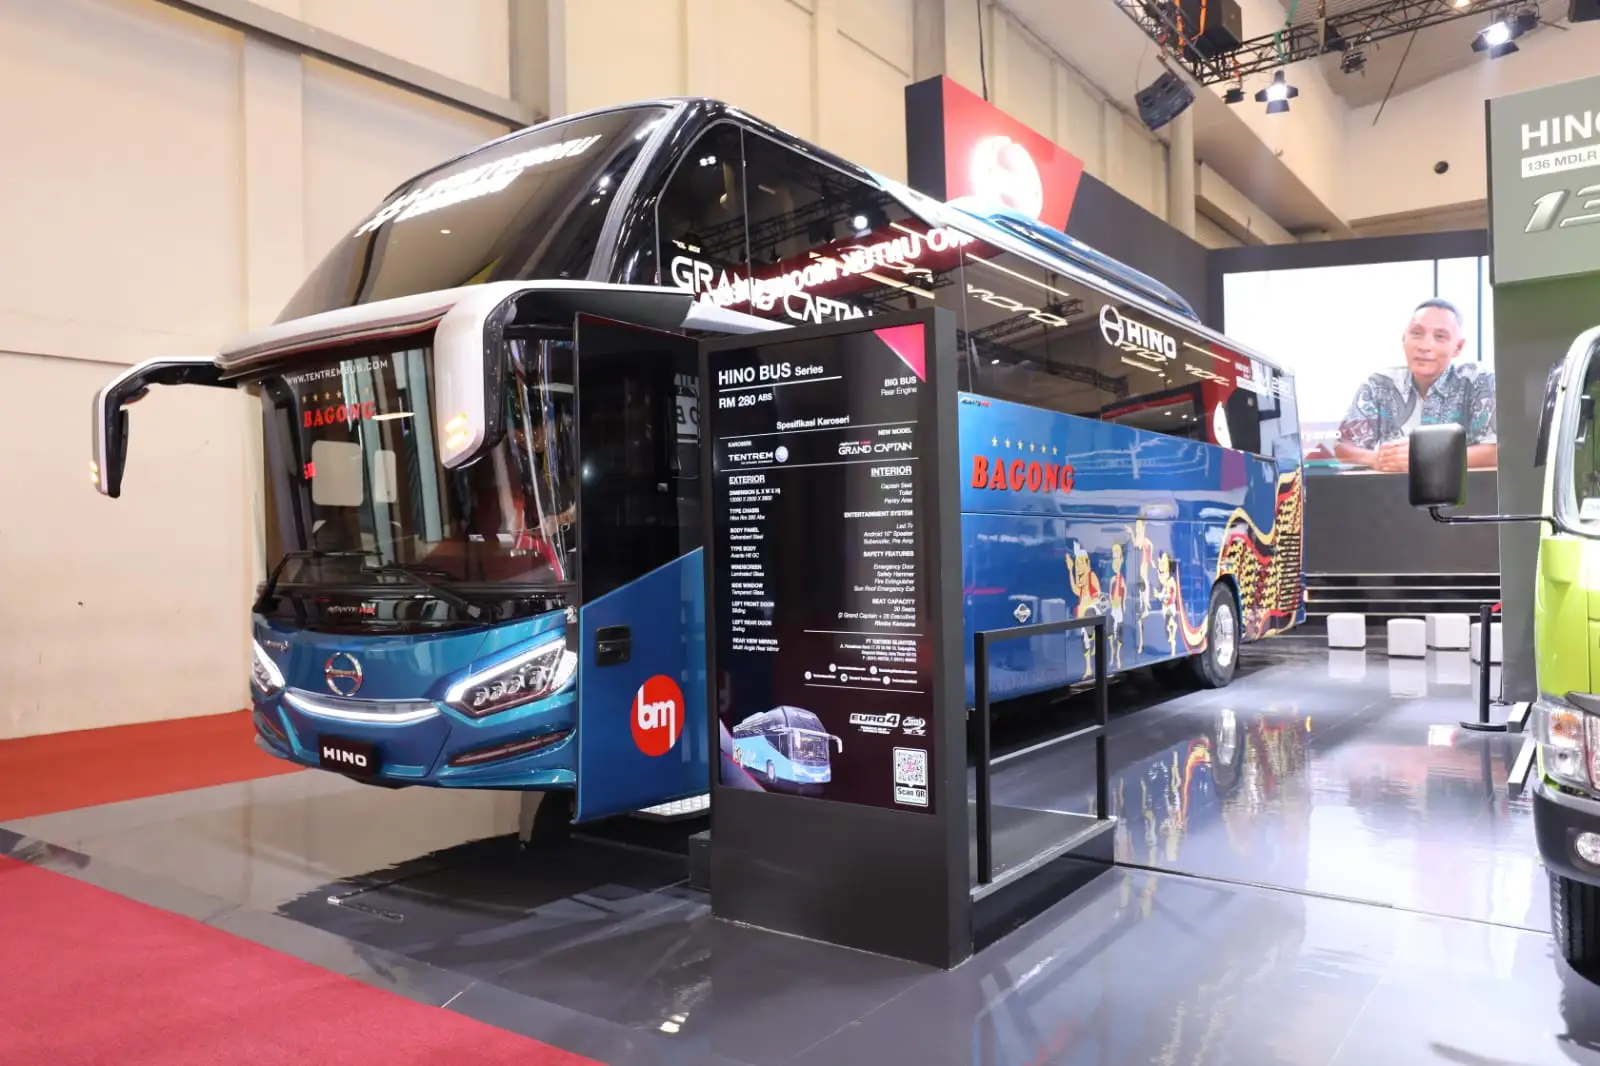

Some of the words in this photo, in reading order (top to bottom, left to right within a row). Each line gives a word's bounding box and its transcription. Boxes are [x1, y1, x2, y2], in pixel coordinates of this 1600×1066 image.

[1521, 110, 1600, 150] HIN
[1528, 159, 1550, 172] 136
[1554, 150, 1597, 169] MDLR
[1127, 320, 1177, 360] HINO
[719, 366, 755, 386] HINO
[759, 362, 791, 381] BUS
[794, 365, 824, 376] Series
[884, 378, 898, 387] BIG
[900, 376, 917, 385] BUS
[881, 388, 895, 396] Rear
[896, 386, 917, 396] Engine
[719, 397, 735, 408] RM
[738, 395, 756, 407] 280
[758, 393, 773, 402] ABS
[303, 401, 375, 428] BAGONG
[817, 415, 850, 427] Karoseri
[838, 445, 872, 455] GRAND
[874, 442, 912, 453] CAPTAIN
[728, 451, 773, 462] TENTREM
[870, 465, 912, 477] INTERIOR
[971, 454, 1076, 494] BAGONG
[729, 474, 765, 485] EXTERIOR
[638, 684, 675, 749] bm
[851, 714, 898, 726] EURO4
[323, 746, 367, 767] HINO
[897, 788, 914, 796] Scan
[916, 789, 925, 798] QR
